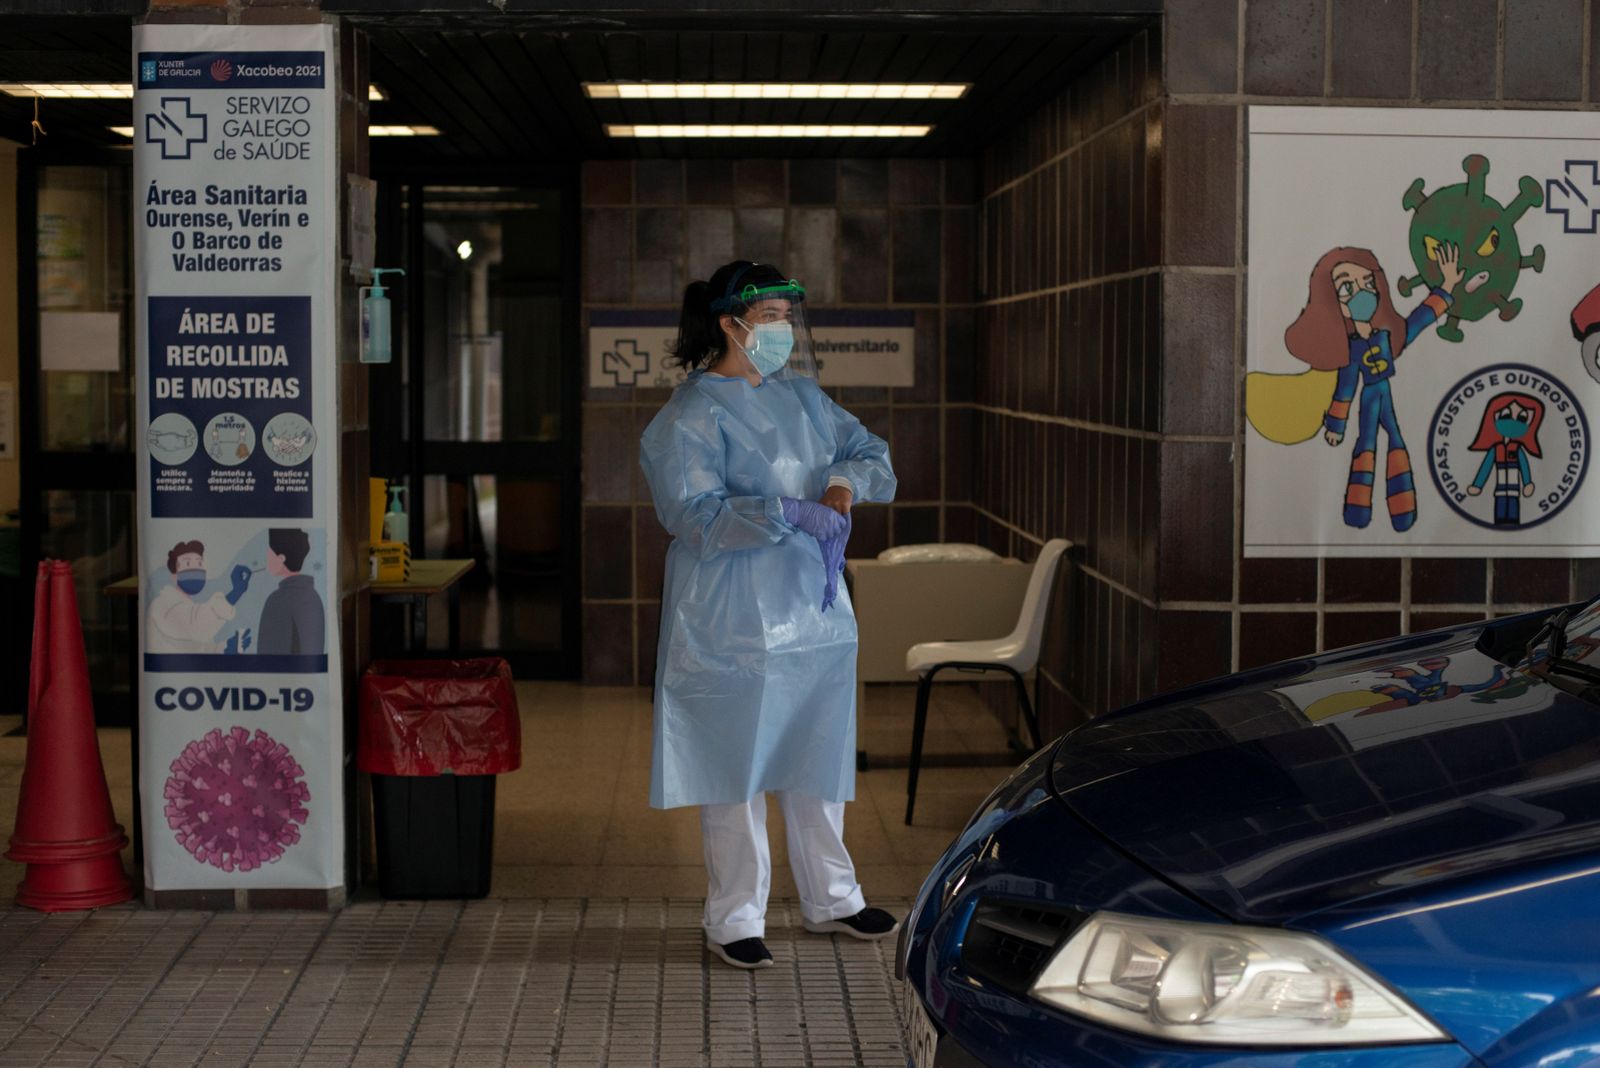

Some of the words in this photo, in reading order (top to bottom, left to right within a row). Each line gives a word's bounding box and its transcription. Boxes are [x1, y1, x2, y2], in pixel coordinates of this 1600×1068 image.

[159, 60, 184, 68] XUNTA
[237, 65, 293, 76] Xacobeo
[296, 66, 321, 76] 2021
[226, 97, 310, 114] SERVIZO
[223, 119, 310, 137] GALEGO
[213, 141, 236, 160] de
[243, 139, 310, 160] SAÚDE
[146, 180, 196, 205] Área
[205, 184, 307, 205] Sanitaria
[146, 209, 233, 231] Ourense,
[238, 209, 290, 227] Verín
[298, 212, 309, 227] e
[172, 232, 185, 250] O
[193, 232, 250, 250] Barco
[258, 232, 282, 250] de
[172, 253, 282, 272] Valdeorras
[178, 308, 239, 334] ÁREA
[246, 313, 276, 334] DE
[166, 345, 289, 366] RECOLLIDA
[155, 378, 184, 398] DE
[192, 378, 300, 398] MOSTRAS
[1489, 374, 1500, 387] E
[1505, 372, 1570, 413] OUTROS
[1438, 379, 1485, 437] SUSTOS
[1436, 442, 1467, 503] PUPAS,
[1538, 415, 1582, 512] DESGUSTOS
[155, 687, 314, 712] COVID-19
